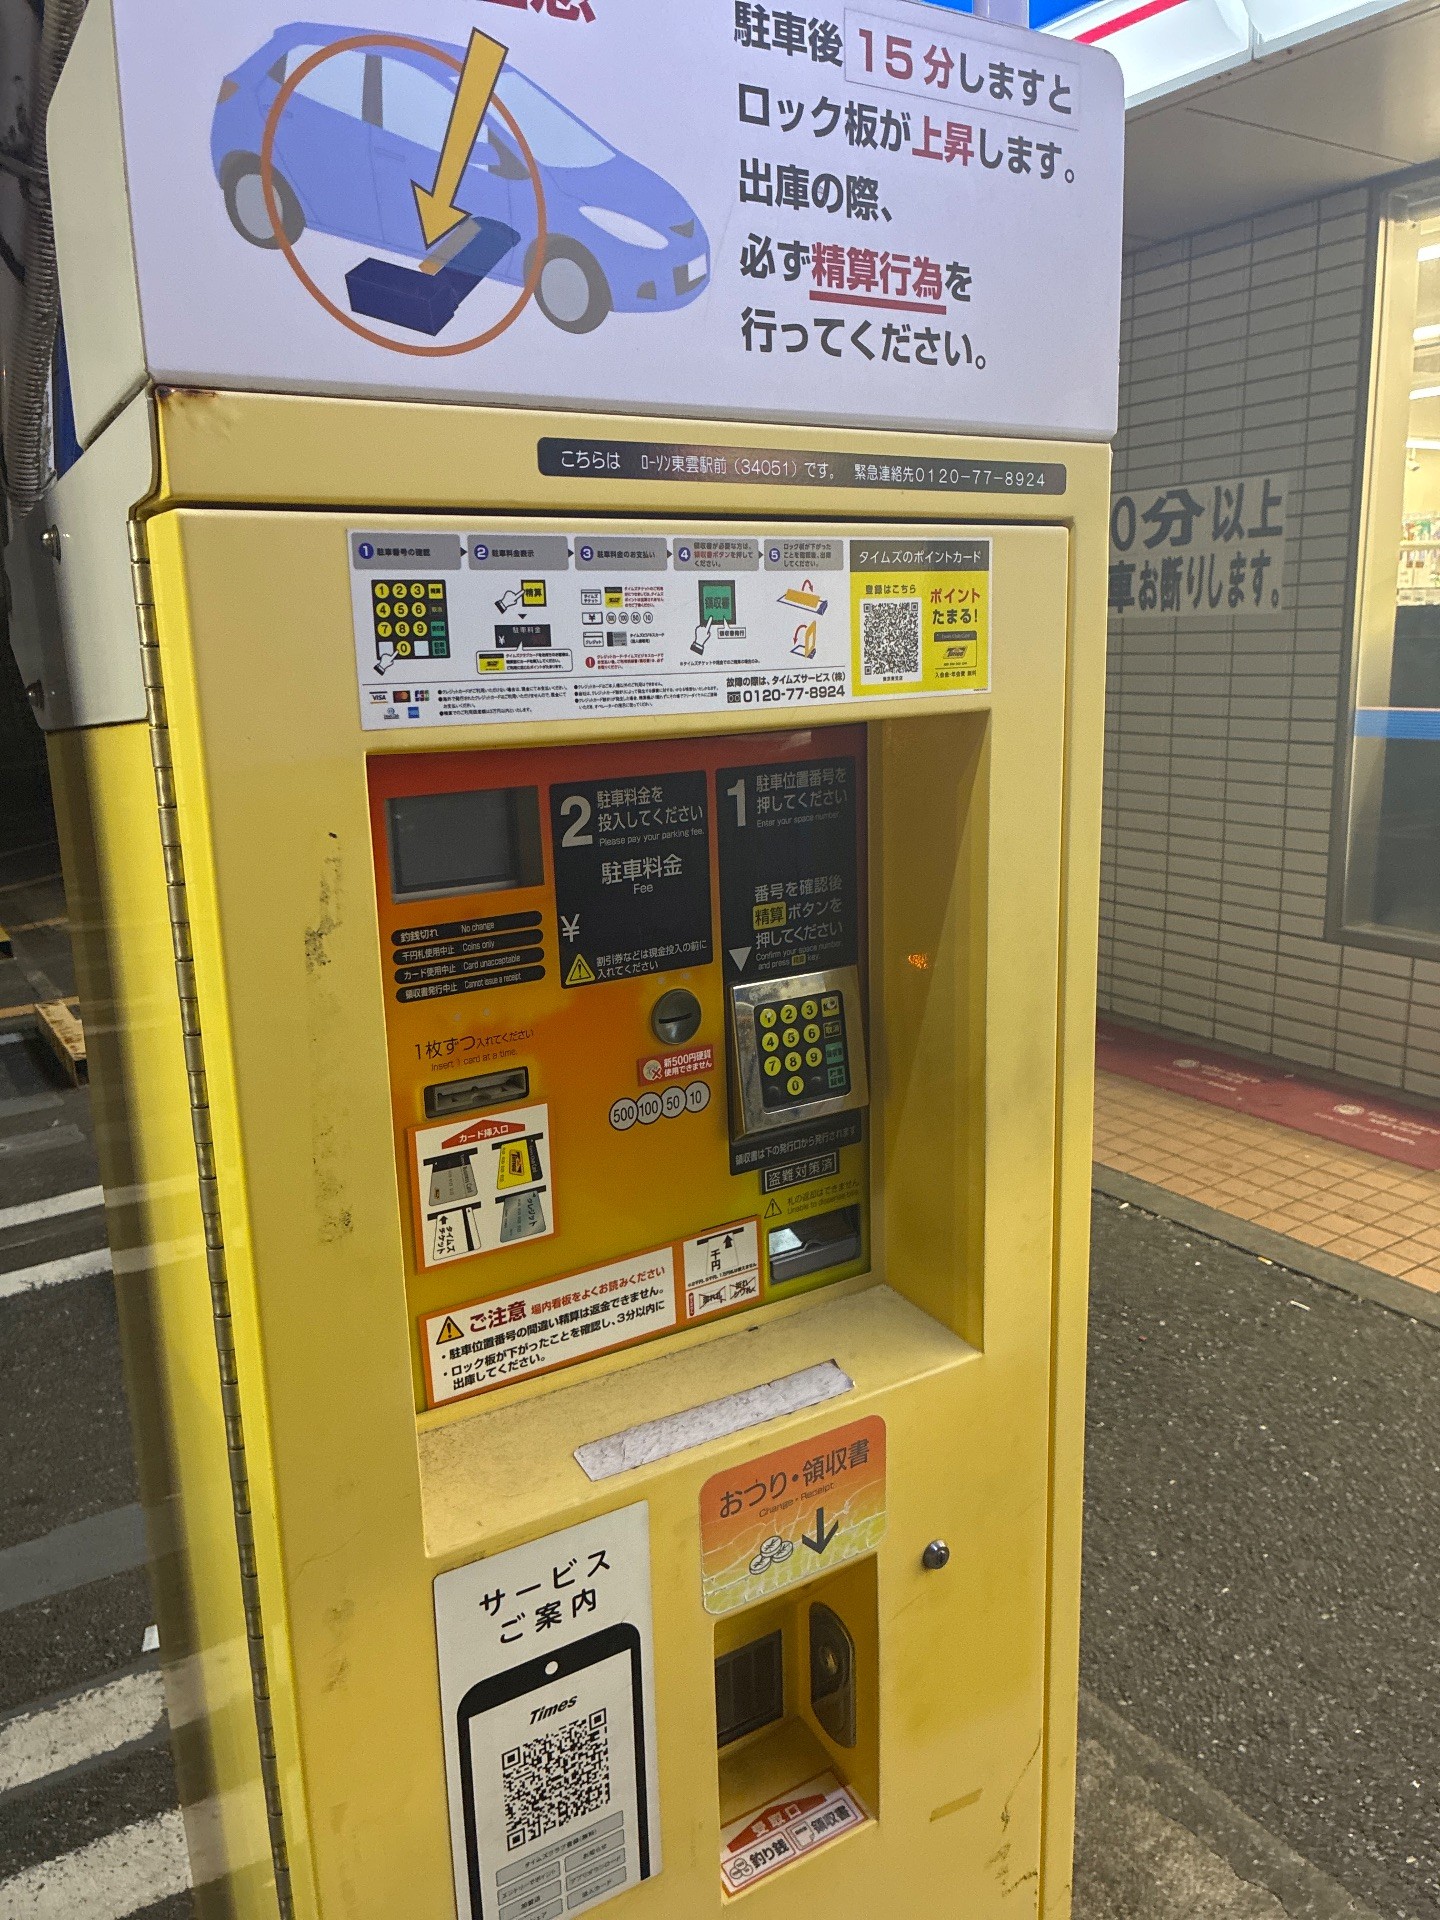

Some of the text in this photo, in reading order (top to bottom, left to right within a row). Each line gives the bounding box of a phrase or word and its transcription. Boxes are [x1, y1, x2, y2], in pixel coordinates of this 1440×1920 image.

[734, 1, 1073, 116] 駐車後15分しますと
[738, 83, 1075, 184] ロック板が上昇します。
[739, 158, 893, 223] 出庫の際、
[739, 232, 973, 302] 必ず精算行為を
[741, 306, 987, 370] 行ってください。
[561, 450, 621, 470] こちらは
[694, 560, 722, 568] ください。
[783, 560, 820, 568] してください。
[859, 550, 981, 564] タイムズのポイントカード
[396, 585, 404, 596] 2
[414, 585, 421, 595] 3
[865, 584, 917, 595] 登録はこちら
[930, 588, 981, 604] ポイント
[380, 604, 387, 615] 4
[398, 604, 405, 615] 5
[415, 604, 422, 615] 6
[381, 624, 388, 634] 7
[399, 624, 406, 634] 8
[417, 624, 424, 634] 9
[743, 684, 846, 703] 0120-77-8924
[755, 767, 847, 794] 駐車位置番号を
[596, 786, 664, 809] 駐車料金を
[727, 778, 747, 828] 1
[756, 788, 848, 815] 押してください
[560, 795, 594, 848] 2
[598, 805, 704, 833] 投入してください
[756, 817, 776, 829] Enter
[777, 815, 792, 827] your
[599, 834, 626, 848] Please
[627, 833, 642, 846] pay
[643, 831, 661, 843] your
[661, 827, 690, 842] parking
[601, 853, 683, 886] 駐車料金
[633, 882, 654, 895] Fee
[754, 874, 843, 904] 番号を確認後
[754, 897, 843, 927] 精算 ボタンを
[400, 921, 495, 944] 釣銭切れ No change
[560, 913, 581, 943] ¥
[755, 920, 843, 951] 押してください
[401, 939, 495, 962] 千円札使用中止 Coins only
[596, 939, 708, 968] 割引券などは現金投入の前に
[755, 951, 782, 963] Confirm
[404, 953, 521, 981] カード使用中止 Card unacceptable
[597, 960, 660, 980] 入れてください
[464, 978, 484, 990] Cannot
[502, 972, 522, 984] receipt
[785, 1007, 793, 1020] 2
[806, 1004, 814, 1016] 3
[414, 1028, 535, 1060] 1枚ずつ入れてください
[766, 1036, 775, 1048] 4
[787, 1032, 795, 1044] 5
[808, 1028, 816, 1040] 6
[431, 1057, 455, 1072] Insert
[463, 1054, 482, 1066] card
[482, 1053, 491, 1064] at
[663, 1049, 712, 1068] 新500円硬貨
[664, 1060, 713, 1078] 使用できません
[768, 1052, 818, 1072] 7 8 9
[792, 1080, 799, 1092] 0
[613, 1090, 702, 1124] 500 100 50 10
[458, 1123, 510, 1144] カード挿入口
[735, 1127, 857, 1166] 領収書は下の発行口から発行されます
[510, 1151, 524, 1175] Times
[768, 1157, 834, 1188] 盗難対策済
[526, 1197, 539, 1228] クレジット
[436, 1227, 446, 1255] チケット
[446, 1225, 456, 1254] タイムズ
[710, 1248, 721, 1272] 千円
[469, 1301, 527, 1333] ご注意
[530, 1265, 666, 1316] 場内看板をよくお読みください
[453, 1354, 547, 1391] 出庫してください。
[719, 1438, 870, 1519] おつり・領収書
[478, 1549, 611, 1617] サービス
[499, 1588, 597, 1644] ご案内
[529, 1695, 578, 1726] Times
[810, 1804, 852, 1835] 領収書
[749, 1838, 791, 1870] 釣り銭
